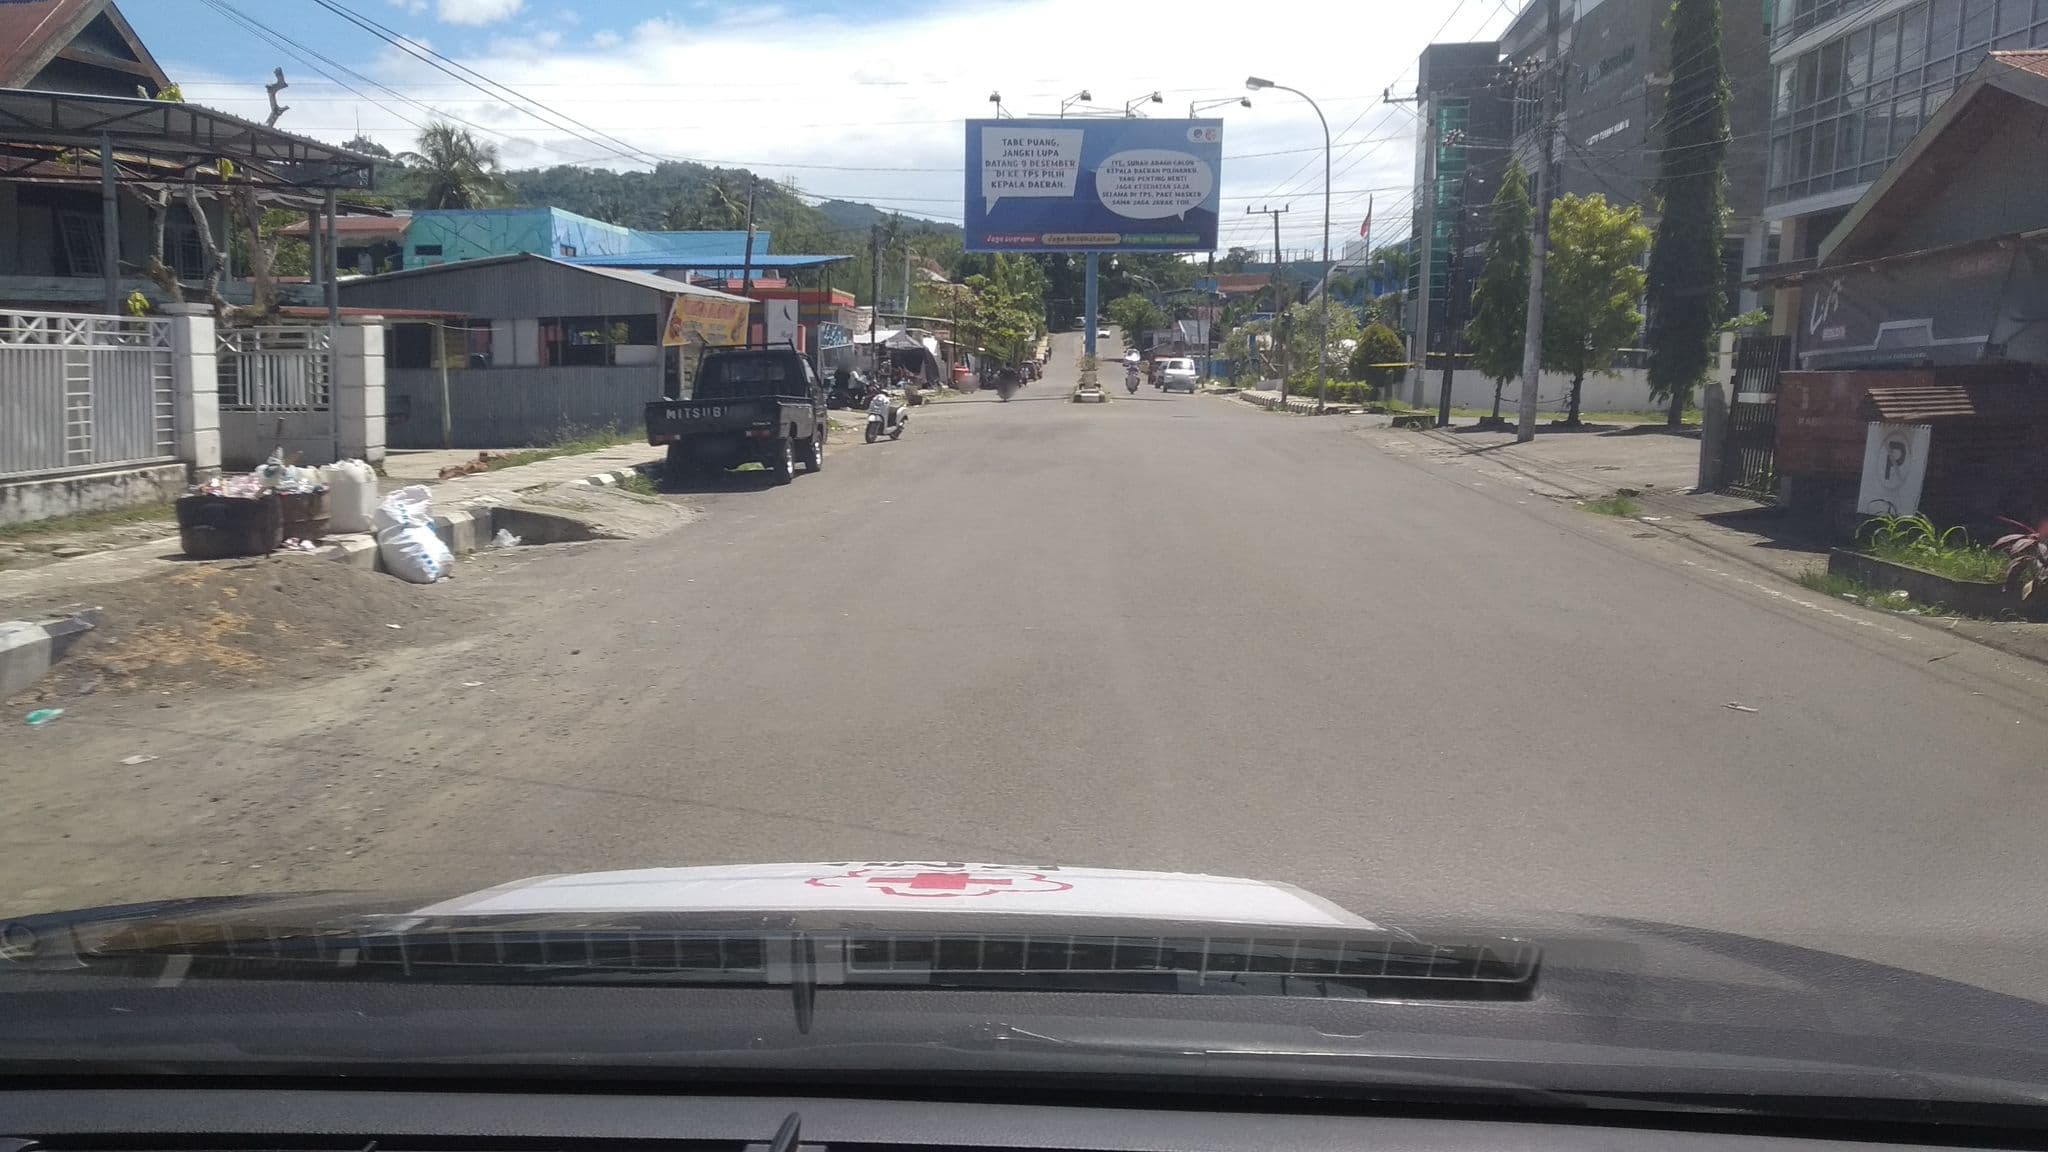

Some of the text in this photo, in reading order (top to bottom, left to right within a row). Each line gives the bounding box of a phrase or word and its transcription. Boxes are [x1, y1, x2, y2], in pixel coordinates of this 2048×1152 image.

[1027, 138, 1059, 147] PUANG,
[1002, 149, 1059, 157] JANGKI LUPA
[985, 160, 1076, 168] DATANG 9 DESEMBER
[1023, 169, 1039, 178] TPS
[1042, 170, 1065, 178] PILIH
[991, 181, 1025, 189] KEPALA
